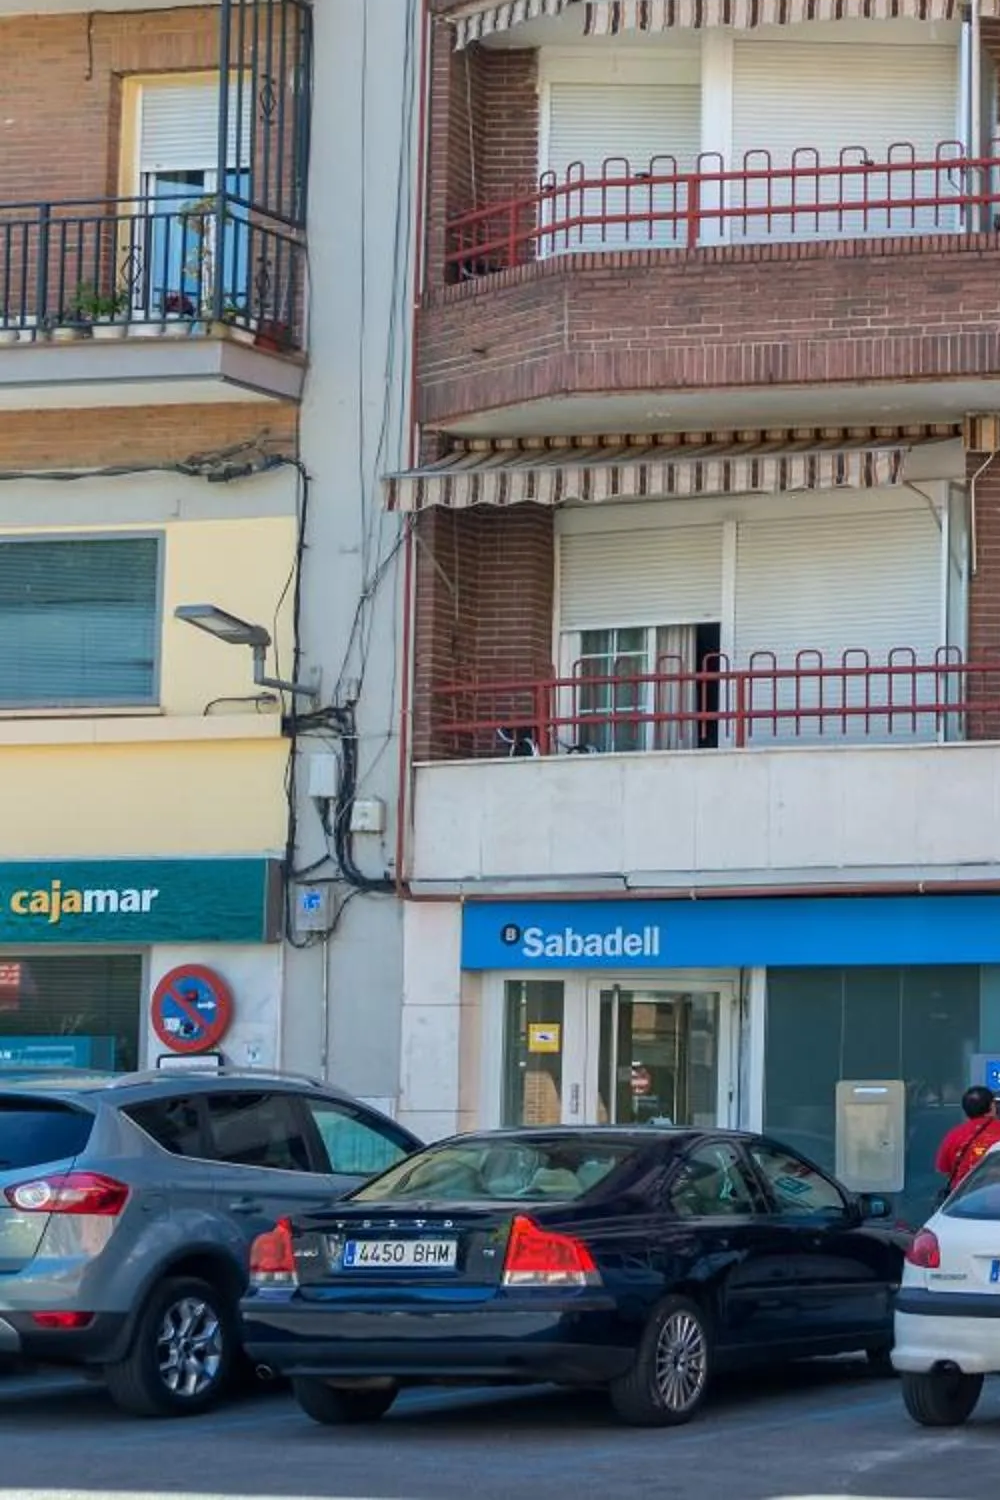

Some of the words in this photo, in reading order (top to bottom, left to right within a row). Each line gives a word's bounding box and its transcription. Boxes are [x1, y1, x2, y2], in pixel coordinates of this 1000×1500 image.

[10, 880, 160, 924] cajamar
[522, 926, 661, 958] Sabadell
[335, 1220, 453, 1229] VOLVO
[359, 1244, 404, 1262] 4450
[413, 1244, 449, 1263] BHM
